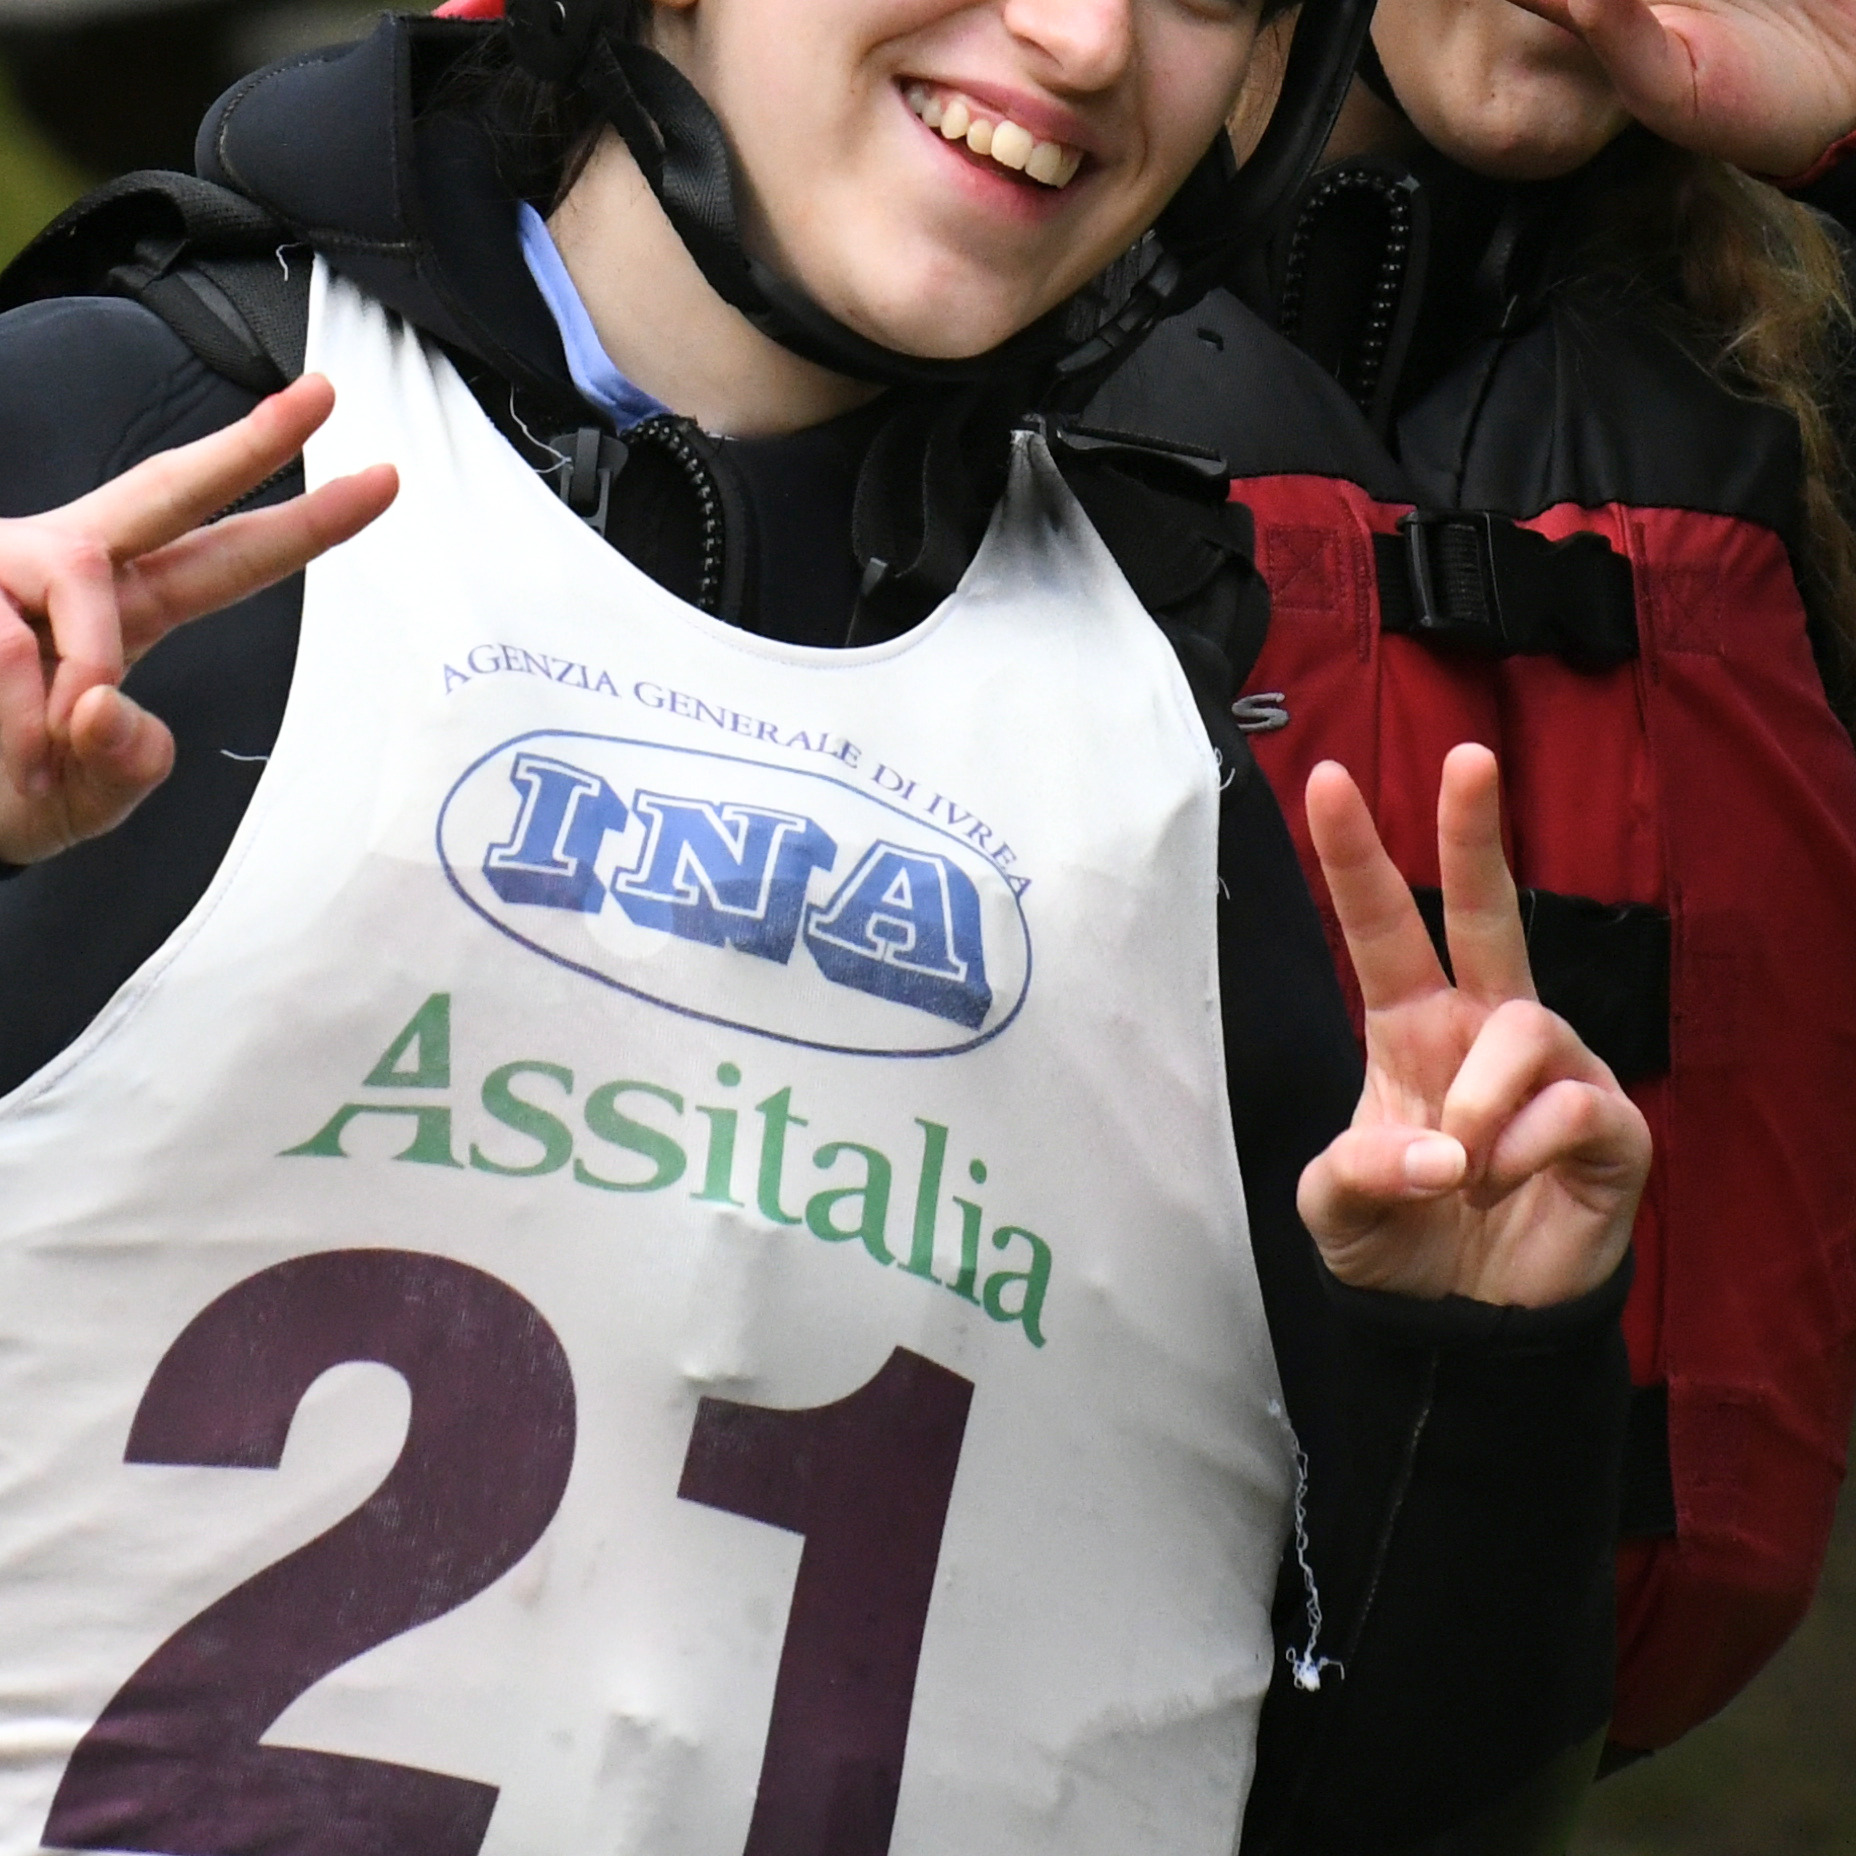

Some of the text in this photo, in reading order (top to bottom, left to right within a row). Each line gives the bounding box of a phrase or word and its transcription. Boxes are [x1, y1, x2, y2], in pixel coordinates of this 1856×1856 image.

[443, 643, 1033, 899] AGENZIA GENERALE DI IVREA
[482, 752, 995, 1031] INA
[275, 991, 1054, 1348] Assitalia
[40, 1247, 975, 1856] 21
